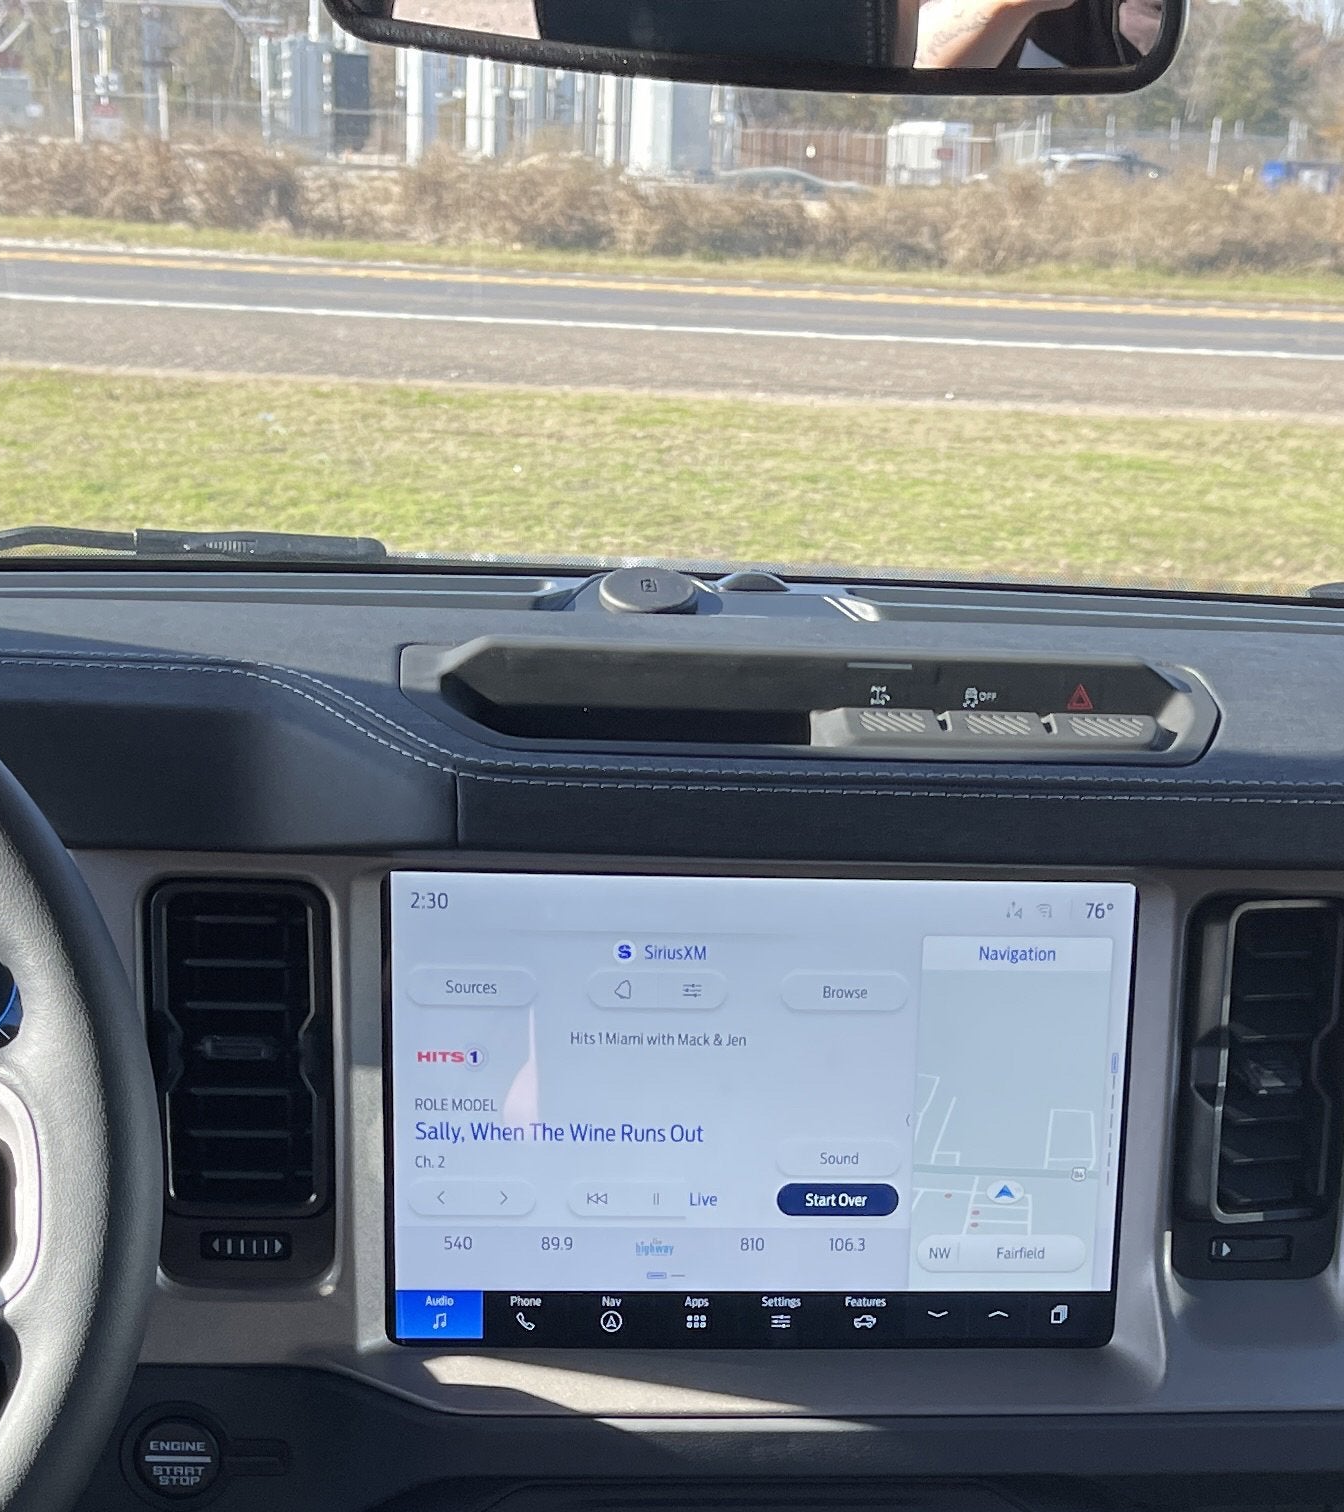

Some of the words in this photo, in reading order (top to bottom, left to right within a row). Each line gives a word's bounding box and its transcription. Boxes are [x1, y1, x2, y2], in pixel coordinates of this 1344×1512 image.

[978, 692, 997, 702] OFF
[410, 892, 449, 910] 2:30
[1085, 902, 1115, 920] 76°
[644, 944, 707, 961] SiriusXM
[978, 946, 1057, 964] Navigation
[445, 979, 498, 995] Sources
[822, 986, 868, 999] Browse
[570, 1032, 596, 1046] Hits
[597, 1032, 604, 1046] 1
[606, 1032, 644, 1046] Miami
[646, 1032, 675, 1046] with
[677, 1032, 710, 1047] Mack
[713, 1034, 723, 1047] &
[726, 1034, 747, 1048] Jen
[416, 1051, 465, 1063] HITS
[469, 1050, 479, 1064] 1
[414, 1098, 448, 1112] ROLE
[451, 1098, 498, 1112] MODEL
[415, 1122, 466, 1144] Sally,
[470, 1123, 525, 1143] When
[529, 1123, 565, 1143] The
[570, 1124, 616, 1143] Wine
[621, 1124, 666, 1143] Runs
[670, 1124, 705, 1144] Out
[414, 1155, 434, 1169] Ch.
[438, 1156, 446, 1169] 2
[820, 1152, 859, 1166] Sound
[689, 1192, 718, 1207] Live
[805, 1193, 836, 1208] Start
[838, 1194, 868, 1208] Over
[444, 1236, 473, 1251] 540
[541, 1236, 574, 1251] 89.9
[636, 1240, 675, 1257] highway
[740, 1238, 765, 1252] 810
[828, 1238, 866, 1252] 106.3
[928, 1248, 951, 1260] NW
[996, 1247, 1046, 1260] Fairfield
[425, 1296, 455, 1307] Audio
[510, 1296, 542, 1308] Phone
[602, 1296, 622, 1308] Nav
[684, 1296, 710, 1309] Apps
[761, 1296, 802, 1309] Settings
[844, 1296, 887, 1309] Features
[149, 1440, 206, 1453] ENGINE
[152, 1466, 205, 1477] START
[158, 1476, 201, 1487] STOP
